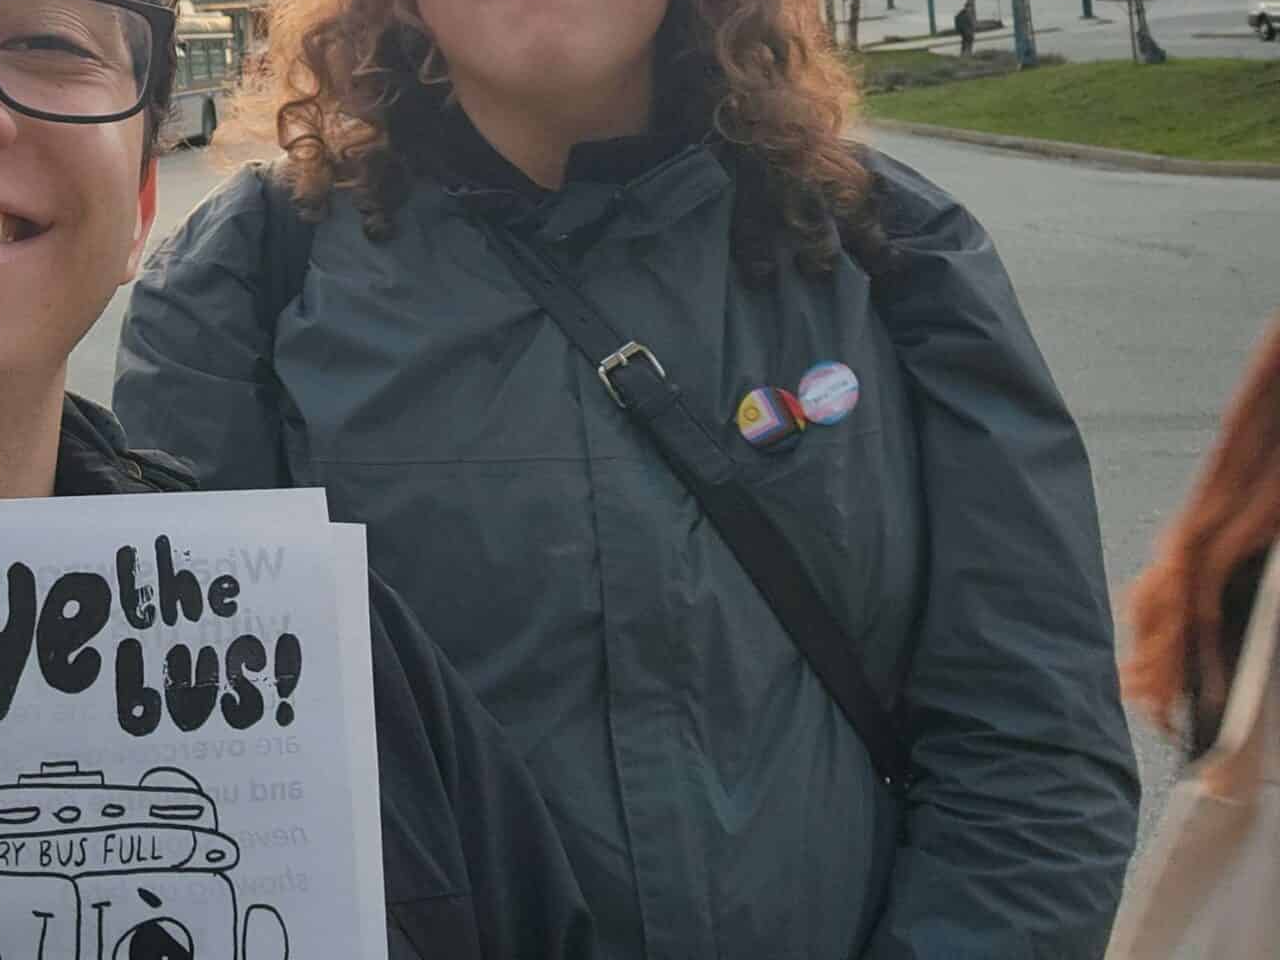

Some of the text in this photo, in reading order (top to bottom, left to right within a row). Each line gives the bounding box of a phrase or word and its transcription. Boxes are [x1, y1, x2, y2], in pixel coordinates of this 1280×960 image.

[116, 534, 240, 629] the
[39, 837, 88, 867] BUS
[103, 833, 164, 865] FULL
